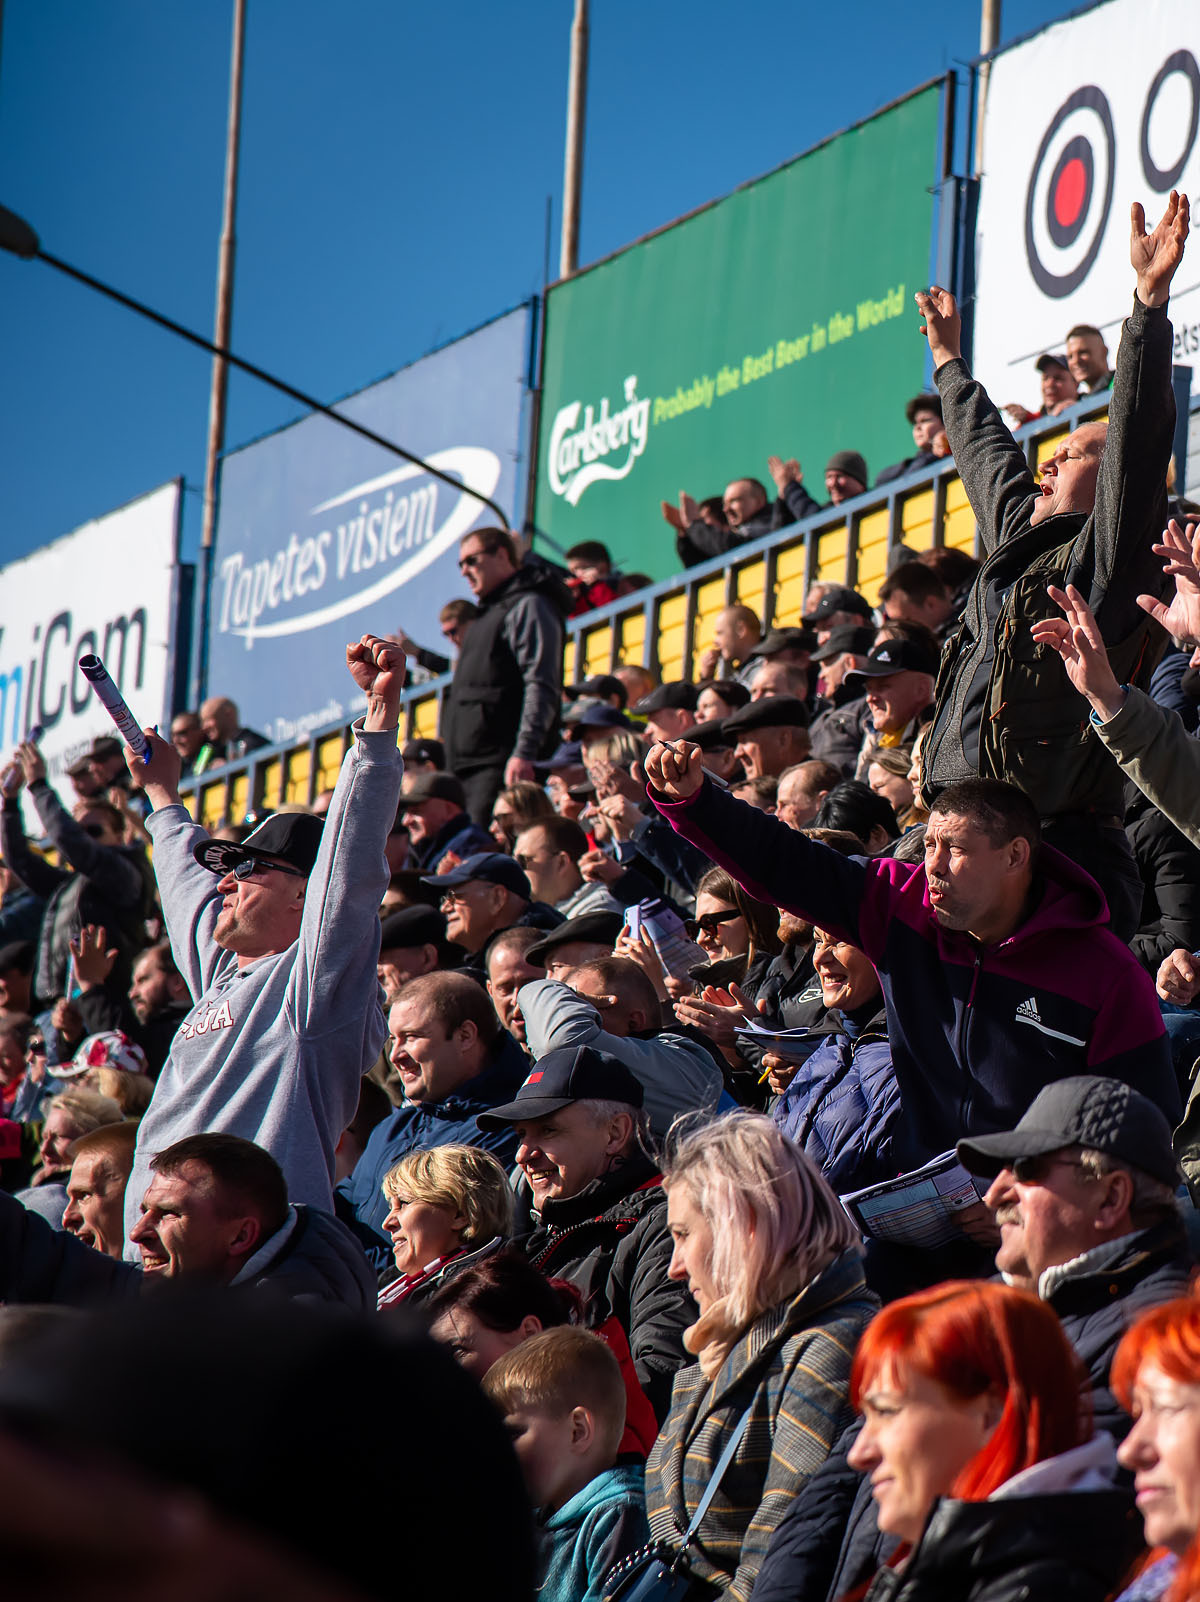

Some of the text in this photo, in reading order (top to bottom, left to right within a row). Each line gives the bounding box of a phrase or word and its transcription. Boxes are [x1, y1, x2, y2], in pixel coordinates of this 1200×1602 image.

[653, 283, 905, 425] Probably the Best Beer in the World
[548, 374, 651, 500] Carlsberg
[219, 482, 438, 651] Tapetes visiem
[1016, 1006, 1041, 1022] adidas
